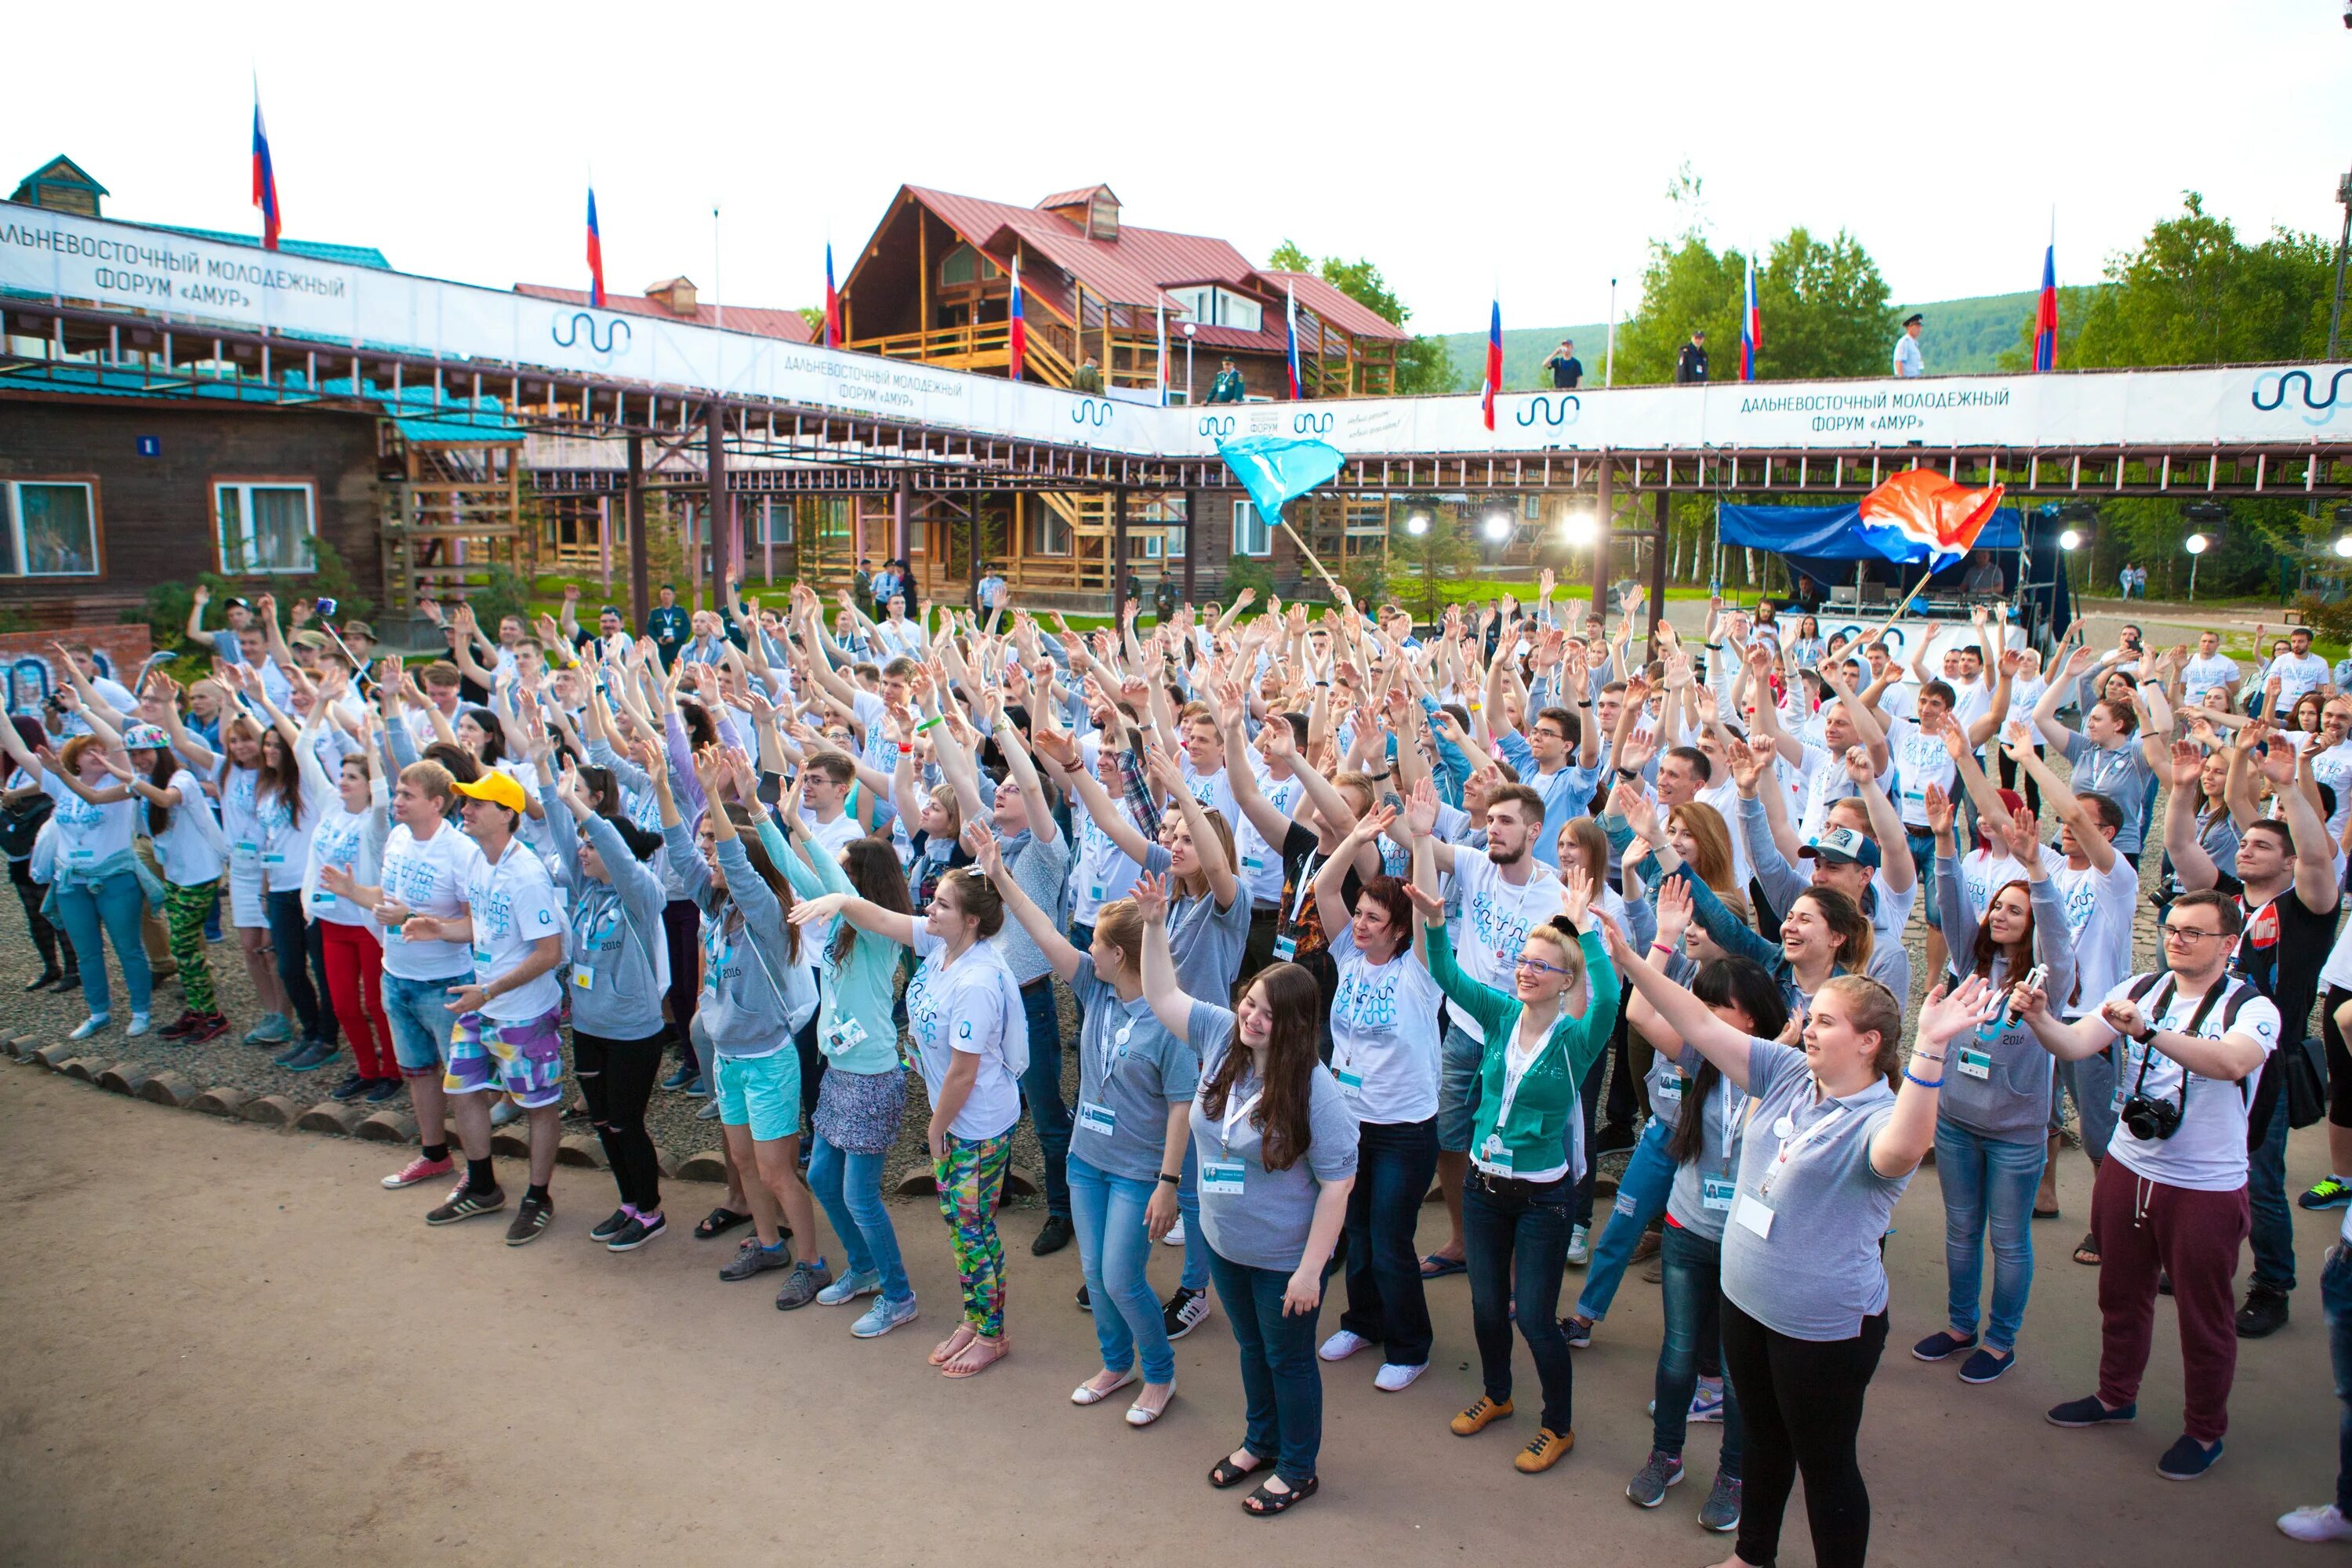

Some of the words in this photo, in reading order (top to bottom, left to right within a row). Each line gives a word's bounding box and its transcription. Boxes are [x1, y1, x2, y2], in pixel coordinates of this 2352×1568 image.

[207, 258, 345, 299] МОЛОДЕЖНЫЙ
[95, 267, 172, 298] ФОРУМ
[180, 283, 250, 308] «АМУР»
[785, 356, 890, 383] ДАЛЬНЕВОСТОЧНЫЙ
[892, 375, 962, 397] МОЛОДЕЖНЫЙ
[839, 383, 877, 402] ФОРУМ
[880, 389, 913, 407] «АМУР»
[1740, 391, 1886, 413] ДАЛЬНЕВОСТОЧНЫЙ
[1893, 387, 2009, 410] МОЛОДЕЖНЫЙ
[1250, 423, 1278, 433] ФОРУМ
[1812, 416, 1864, 432] ФОРУМ
[1871, 415, 1924, 431] «АМУР»
[144, 438, 153, 453] 1
[601, 939, 622, 952] 2016
[722, 966, 742, 978] 2016
[2002, 1034, 2025, 1046] 2016
